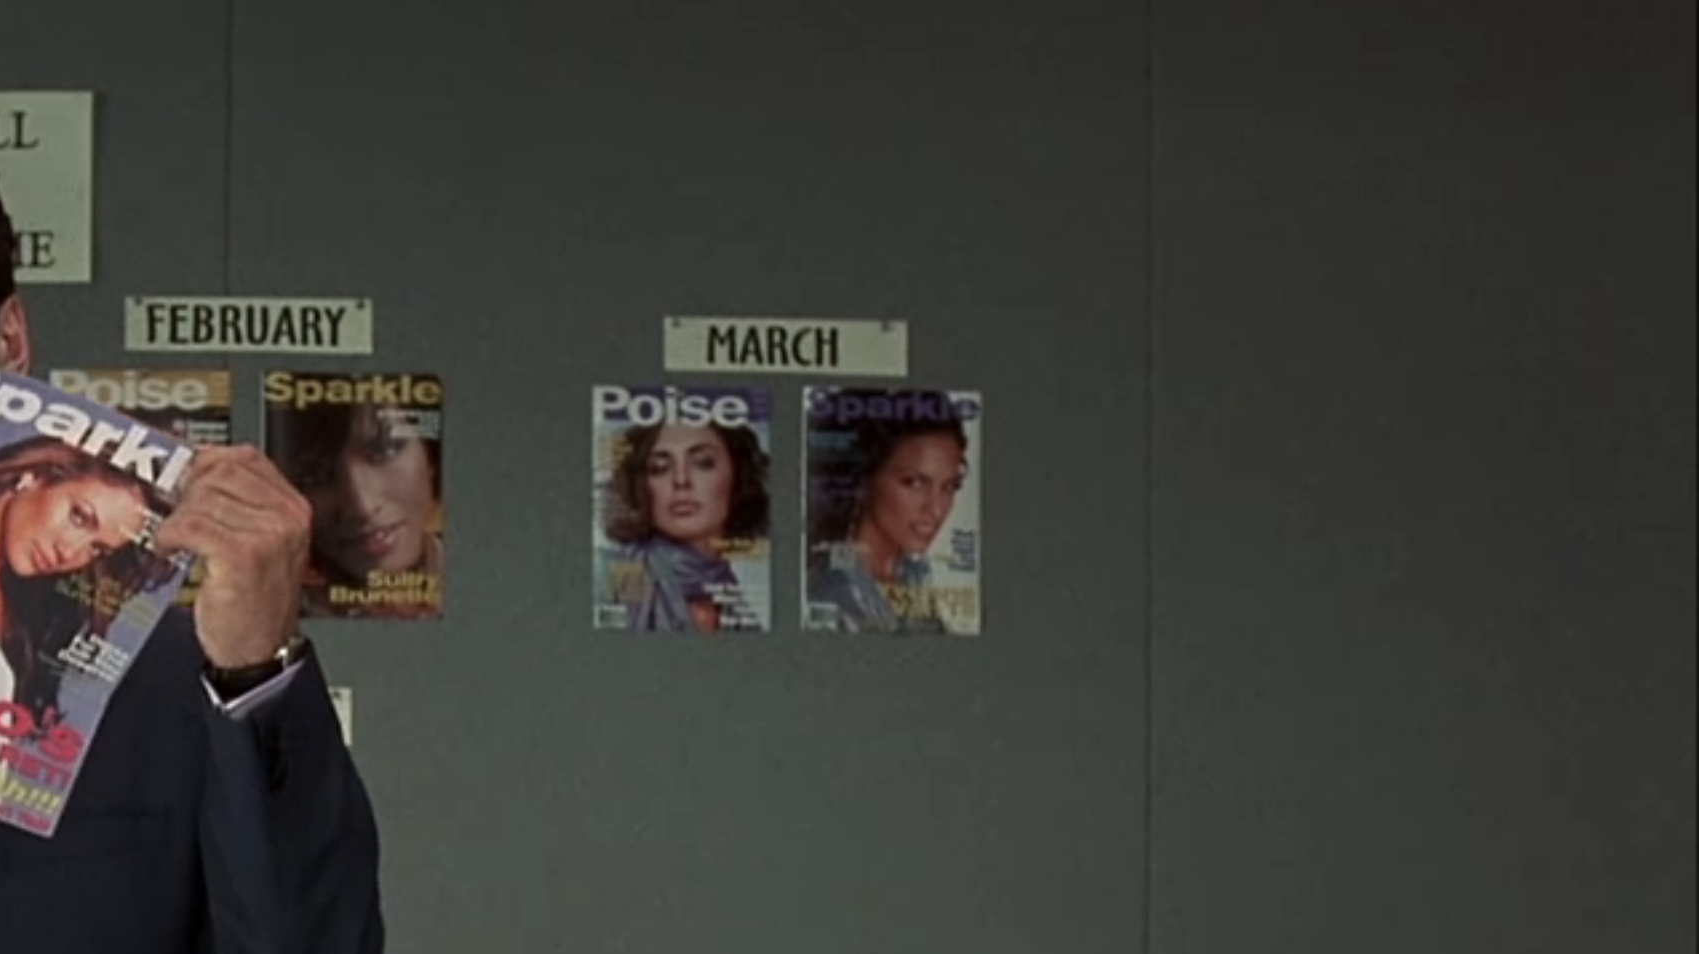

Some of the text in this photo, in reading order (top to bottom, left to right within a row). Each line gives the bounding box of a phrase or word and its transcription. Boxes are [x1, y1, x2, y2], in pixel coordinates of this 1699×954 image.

[146, 303, 346, 347] FEBRUARY
[706, 324, 839, 367] MARCH
[50, 369, 208, 411] Poise
[264, 371, 442, 410] Sparkle
[592, 385, 749, 428] Poise
[809, 385, 983, 424] Sparkle
